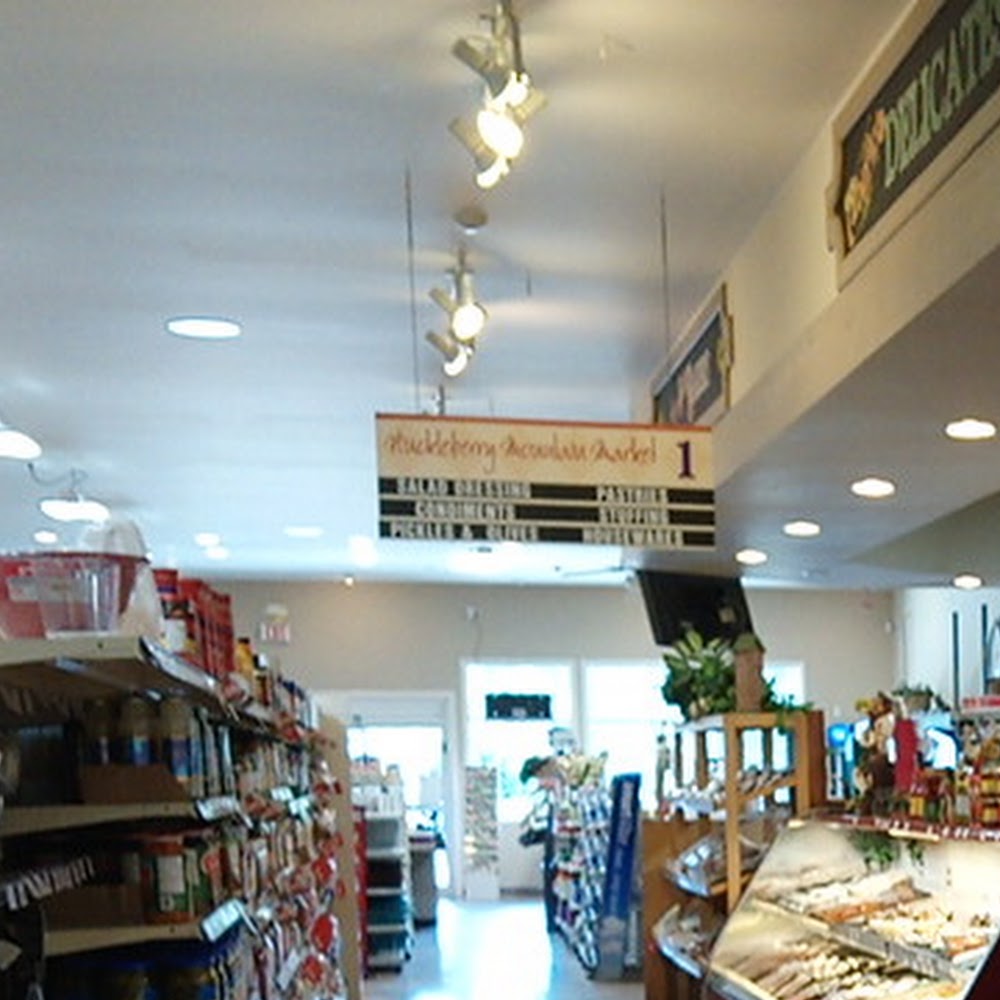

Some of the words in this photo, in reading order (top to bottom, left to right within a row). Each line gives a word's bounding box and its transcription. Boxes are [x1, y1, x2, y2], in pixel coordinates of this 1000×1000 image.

[676, 440, 696, 479] 1
[397, 477, 448, 496] SALAD
[454, 480, 531, 499] DRESSING
[415, 499, 516, 520] CONDIMENTS
